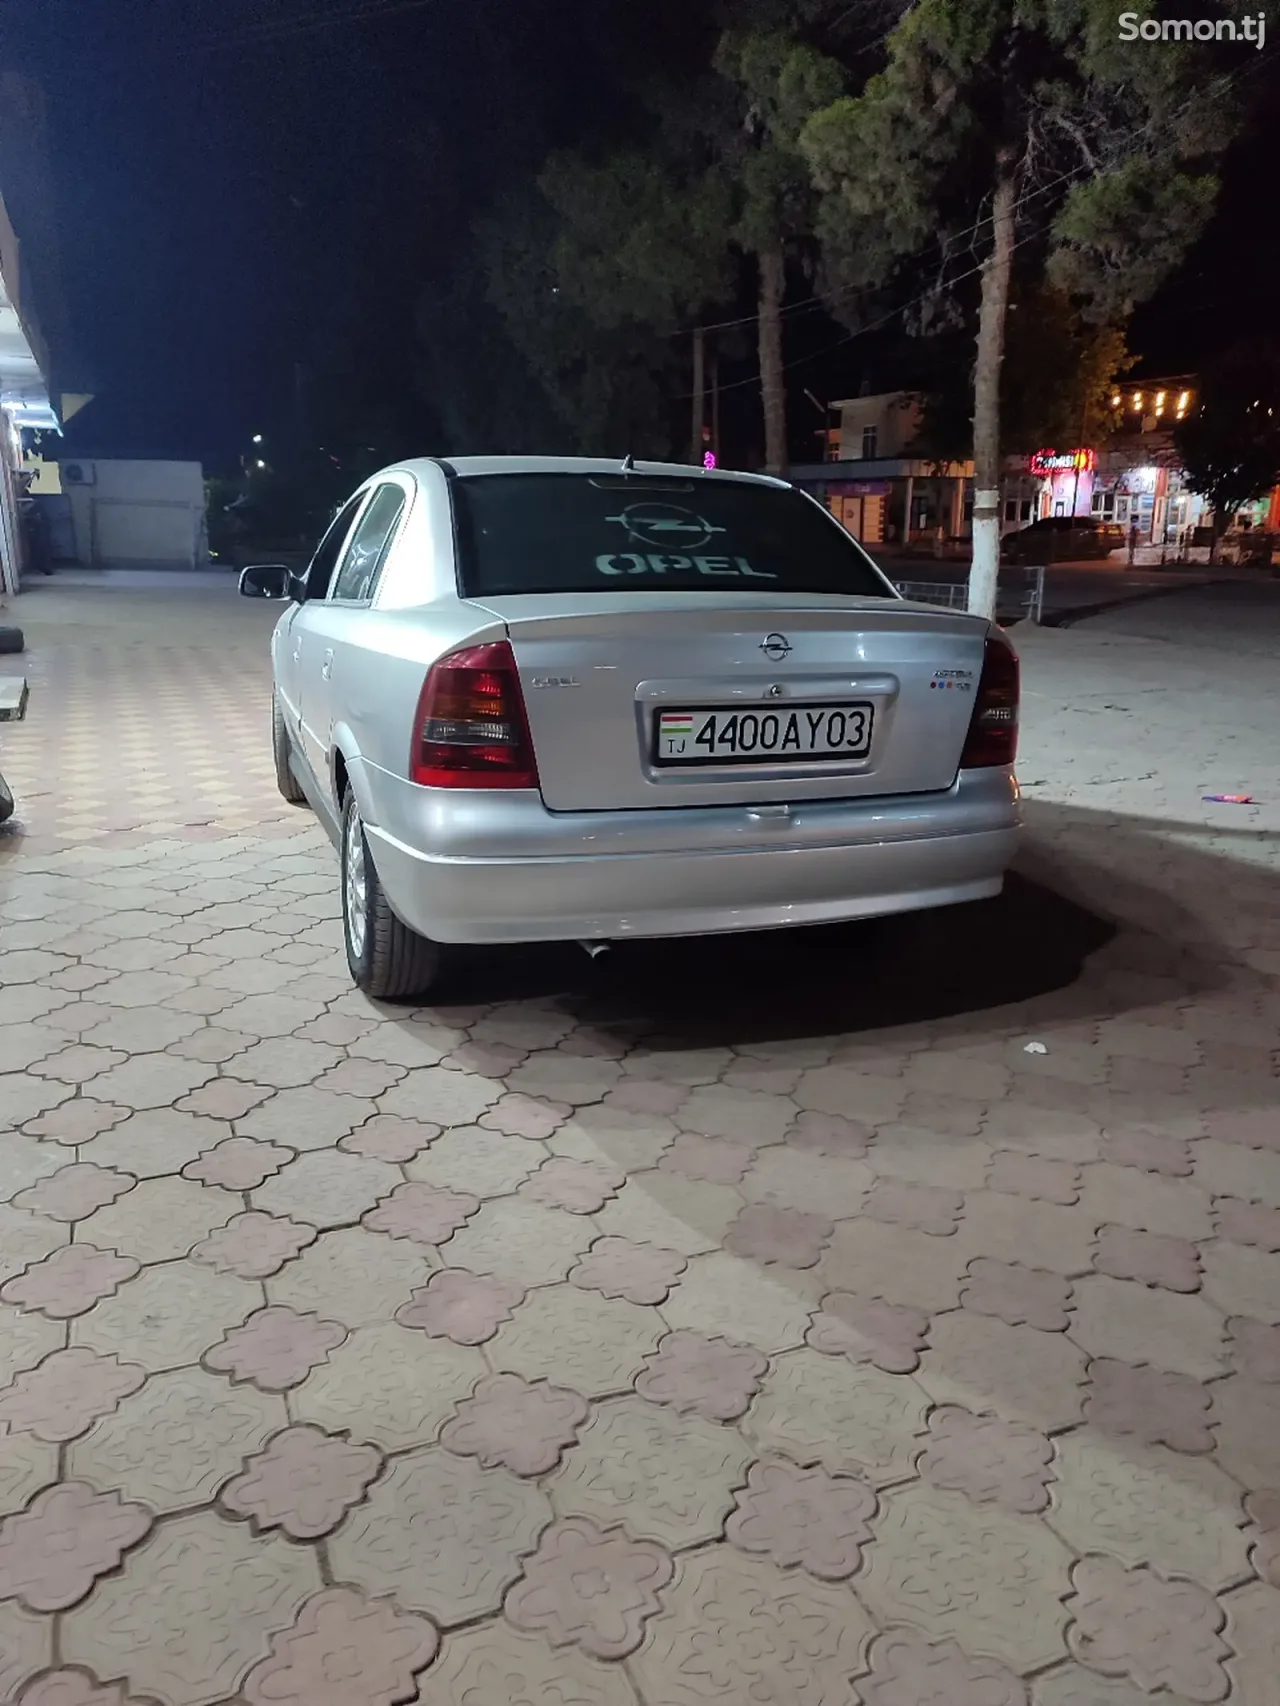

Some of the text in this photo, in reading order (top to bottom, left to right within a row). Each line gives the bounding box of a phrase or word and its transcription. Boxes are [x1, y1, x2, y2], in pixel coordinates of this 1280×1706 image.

[595, 553, 778, 578] OPEL
[695, 711, 866, 753] 4400AY03
[667, 739, 686, 753] TJ
